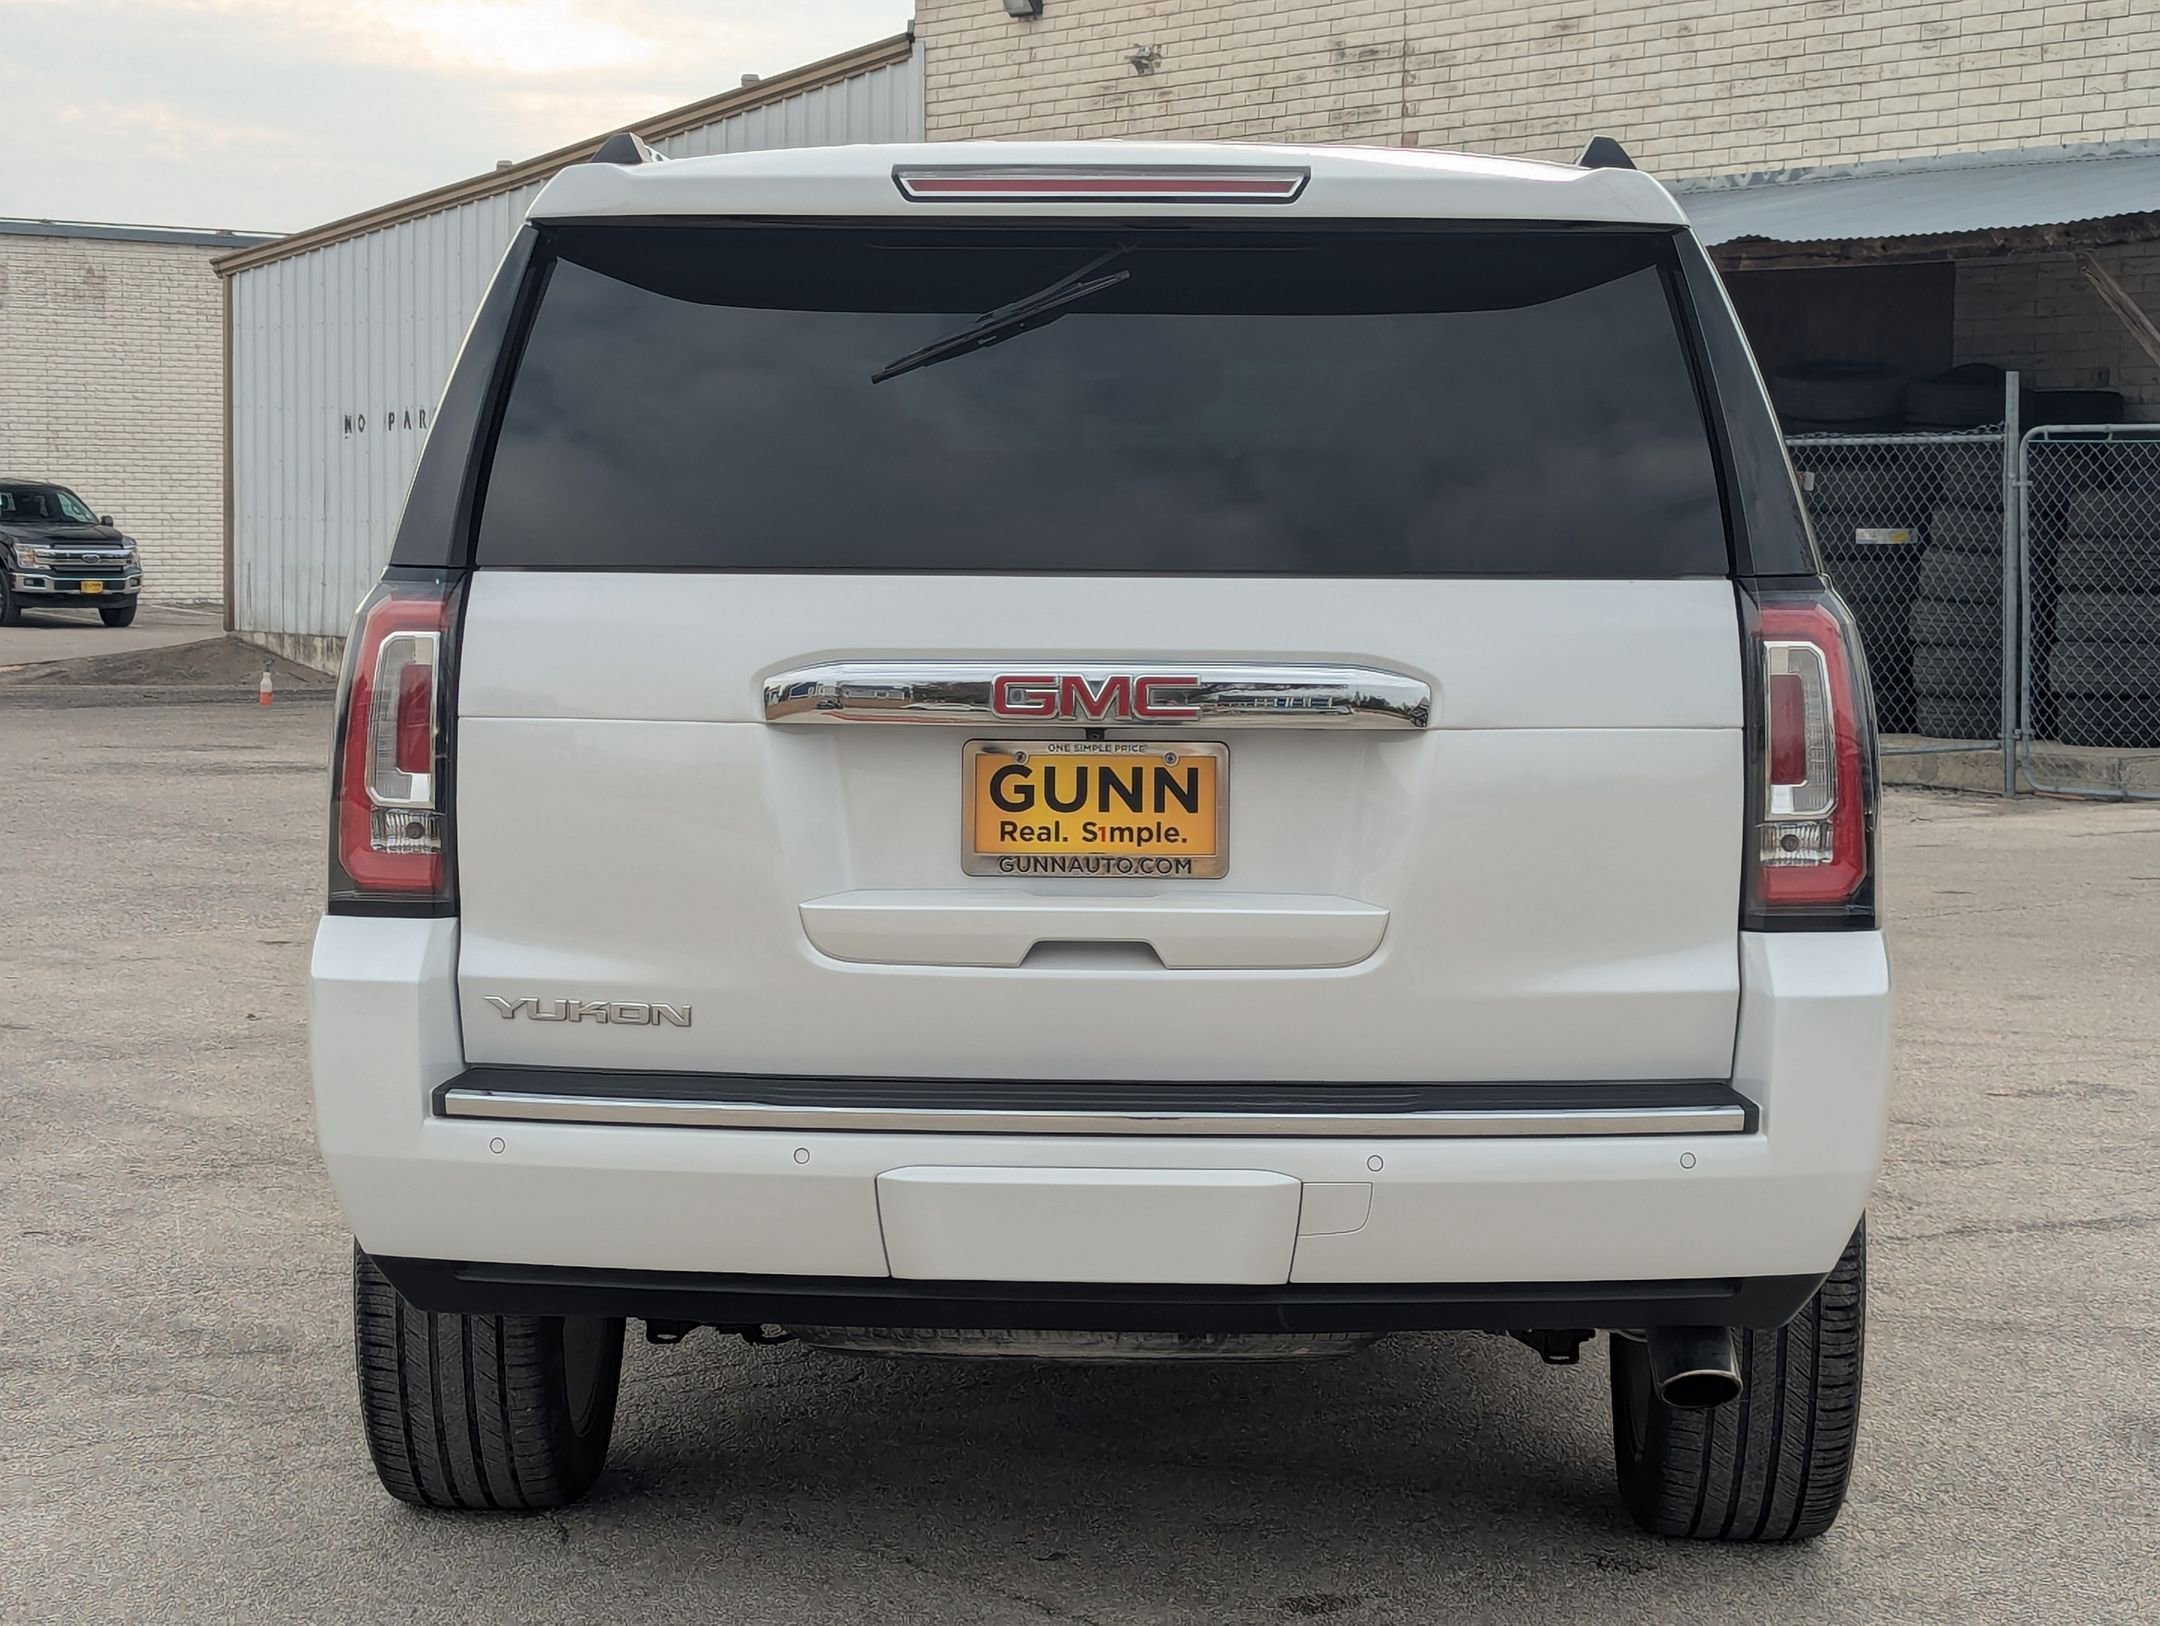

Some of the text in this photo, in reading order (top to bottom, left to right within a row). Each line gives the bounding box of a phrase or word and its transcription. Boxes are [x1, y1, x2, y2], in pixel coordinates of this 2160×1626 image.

[345, 408, 436, 434] NO PAR
[992, 674, 1200, 720] GMC
[1047, 743, 1072, 753] ONE
[1073, 743, 1112, 753] SIMPLE
[989, 764, 1199, 813] GUNN
[1000, 820, 1068, 843] Real.
[998, 855, 1192, 875] GUNNAUTO.COM
[483, 995, 692, 1027] YUKON
